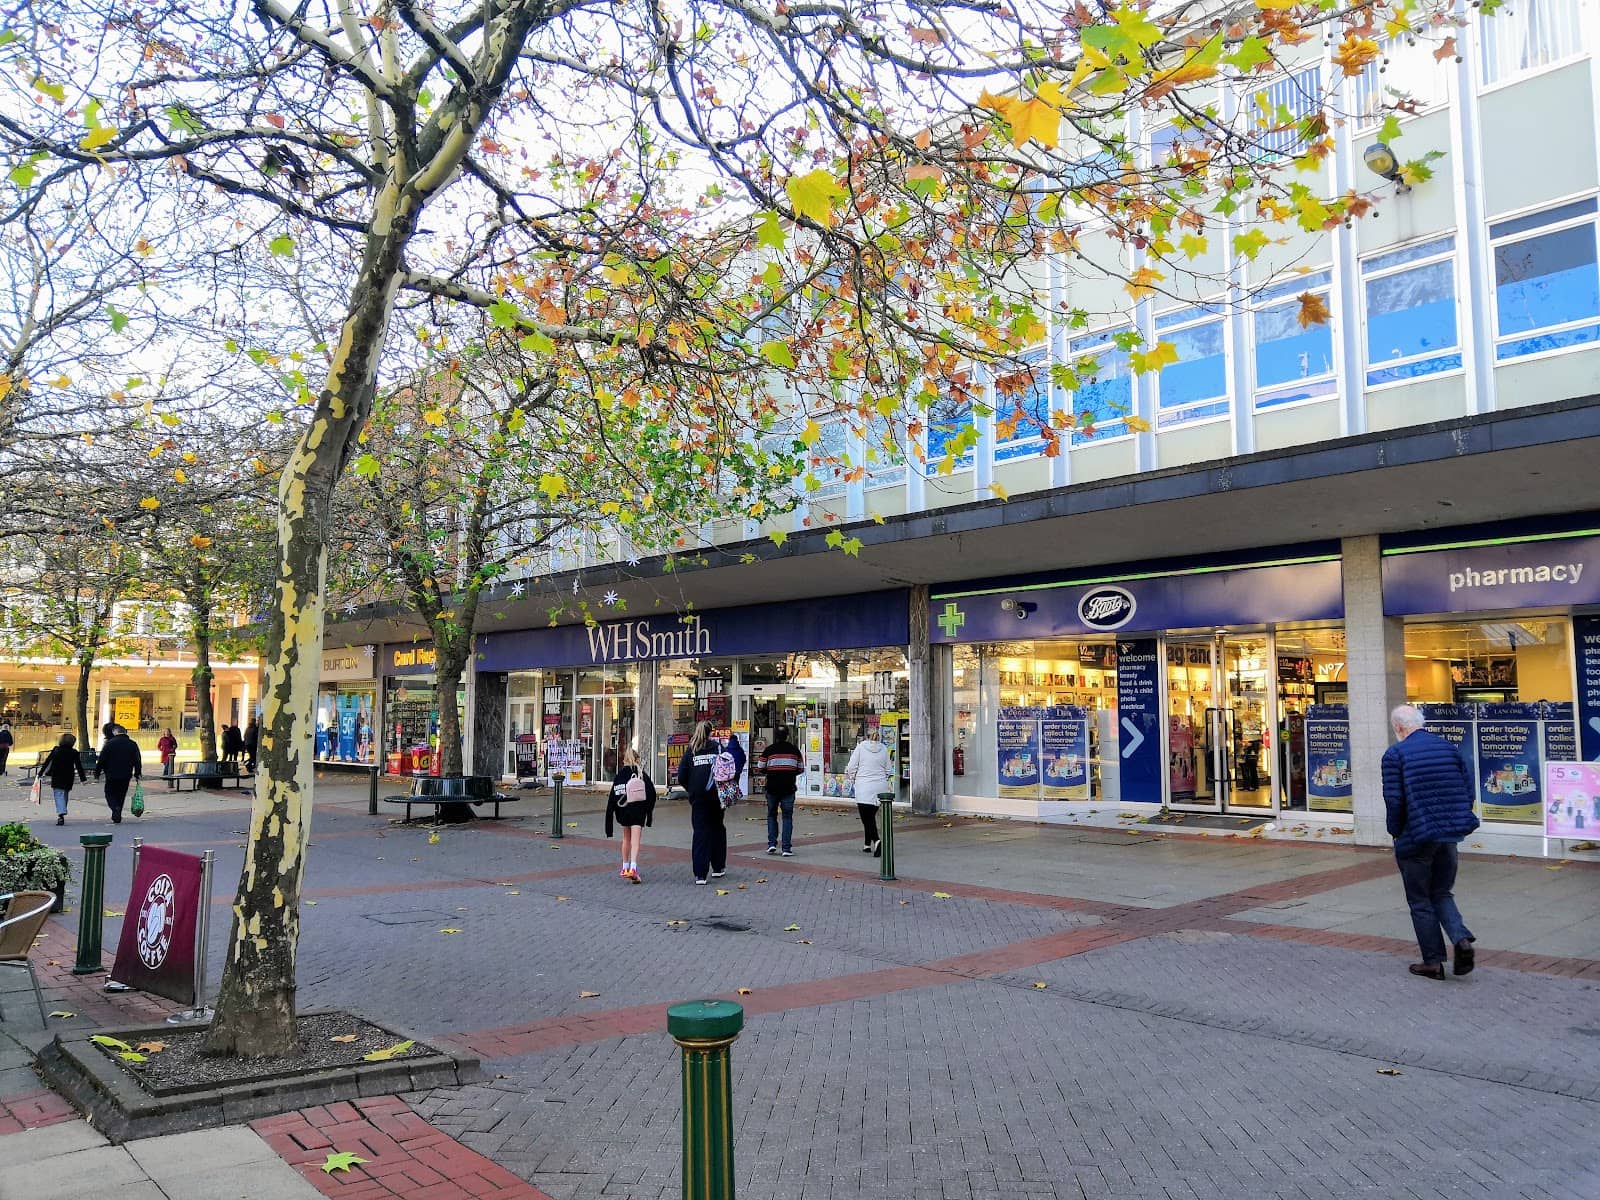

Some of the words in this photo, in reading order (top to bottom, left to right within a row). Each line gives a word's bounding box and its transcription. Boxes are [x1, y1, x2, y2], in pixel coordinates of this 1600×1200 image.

[1449, 563, 1583, 592] pharmacy
[1086, 596, 1130, 619] Boots
[586, 615, 713, 663] WHSmith
[1119, 653, 1156, 663] welcome
[323, 656, 358, 672] BURTON
[868, 694, 897, 709] PRICE
[1061, 723, 1080, 731] today,
[1310, 724, 1328, 732] order
[1329, 724, 1351, 733] today,
[1442, 725, 1466, 734] today,
[1480, 725, 1503, 733] order
[1504, 725, 1530, 735] today,
[1548, 725, 1573, 733] order
[1333, 732, 1348, 740] free
[1447, 733, 1463, 741] free
[1481, 734, 1508, 742] collect
[1510, 734, 1527, 742] free
[1548, 734, 1575, 742] collec
[1549, 743, 1576, 751] tomor
[148, 878, 174, 908] COSTA
[139, 927, 169, 966] COFFEE
